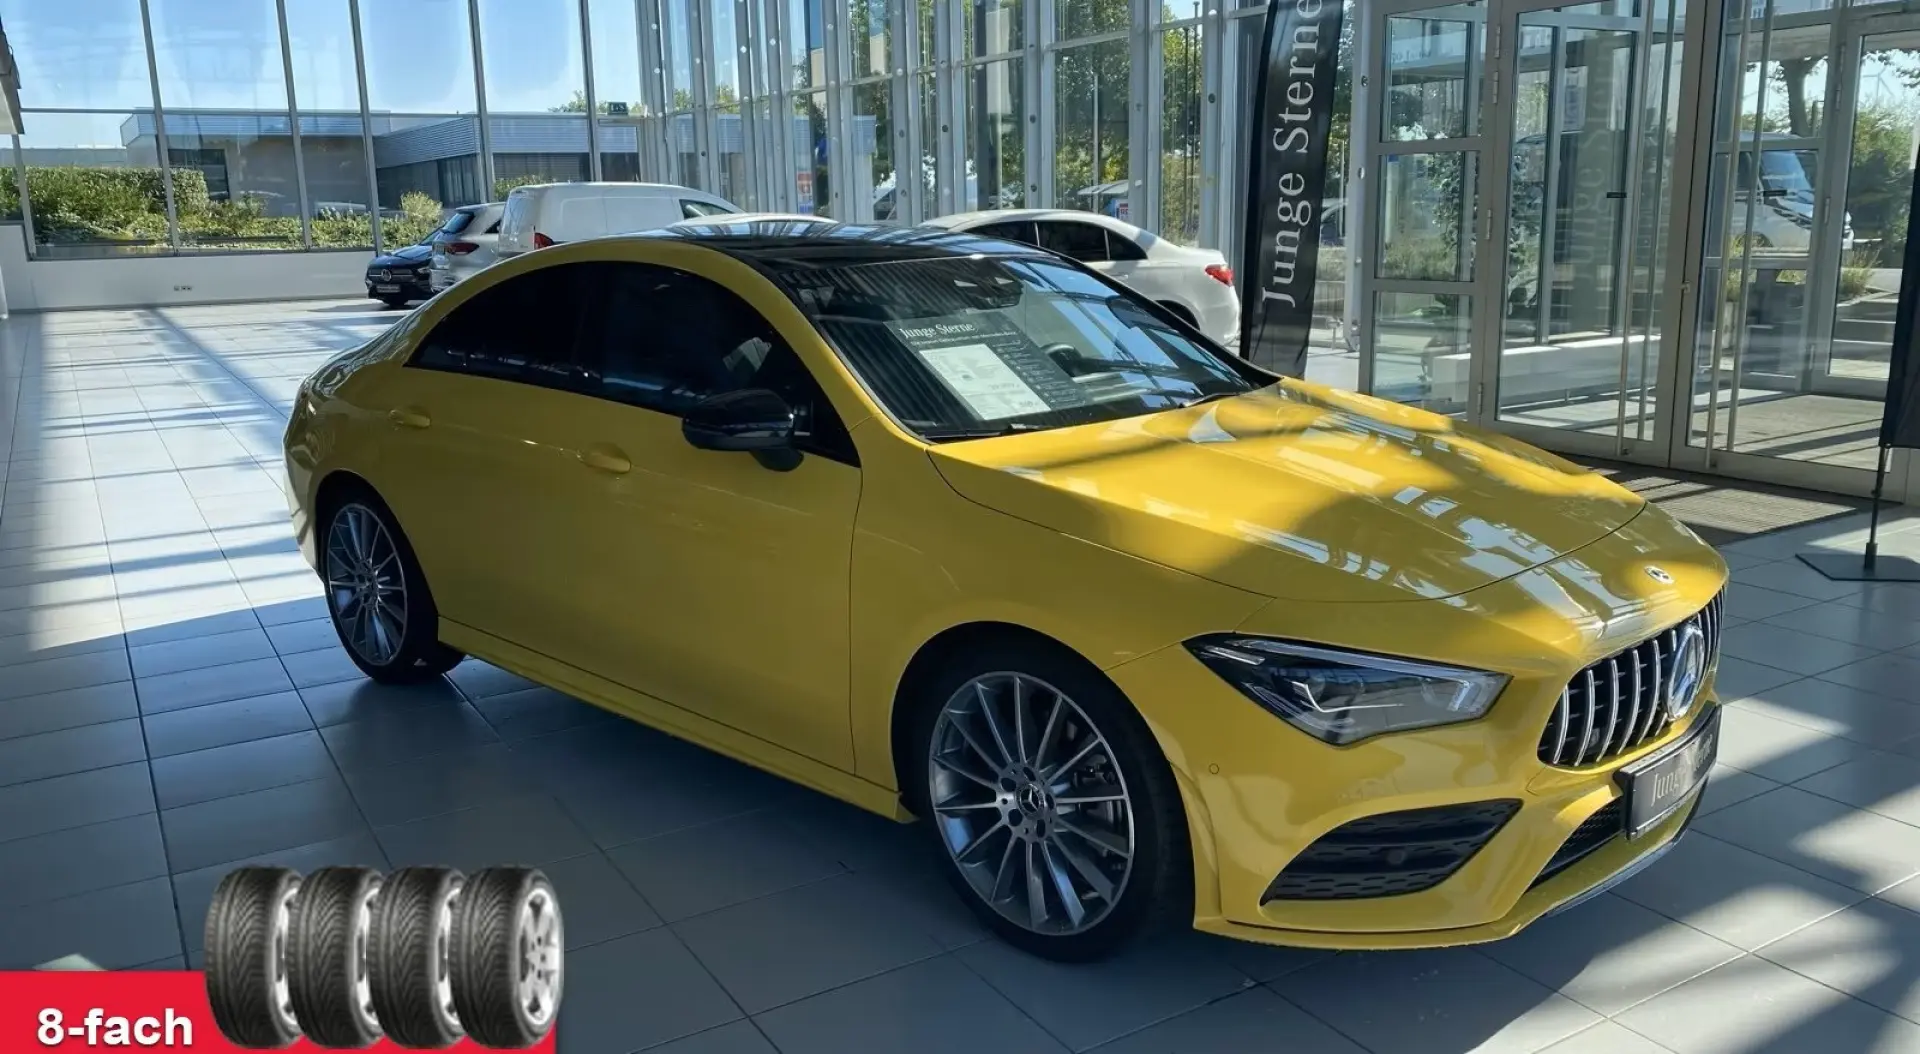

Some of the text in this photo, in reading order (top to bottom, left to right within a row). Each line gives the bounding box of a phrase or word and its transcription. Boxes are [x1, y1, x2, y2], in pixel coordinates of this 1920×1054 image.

[1262, 0, 1322, 308] Junge Sterne
[899, 327, 937, 339] Junge
[935, 323, 975, 335] Sterne
